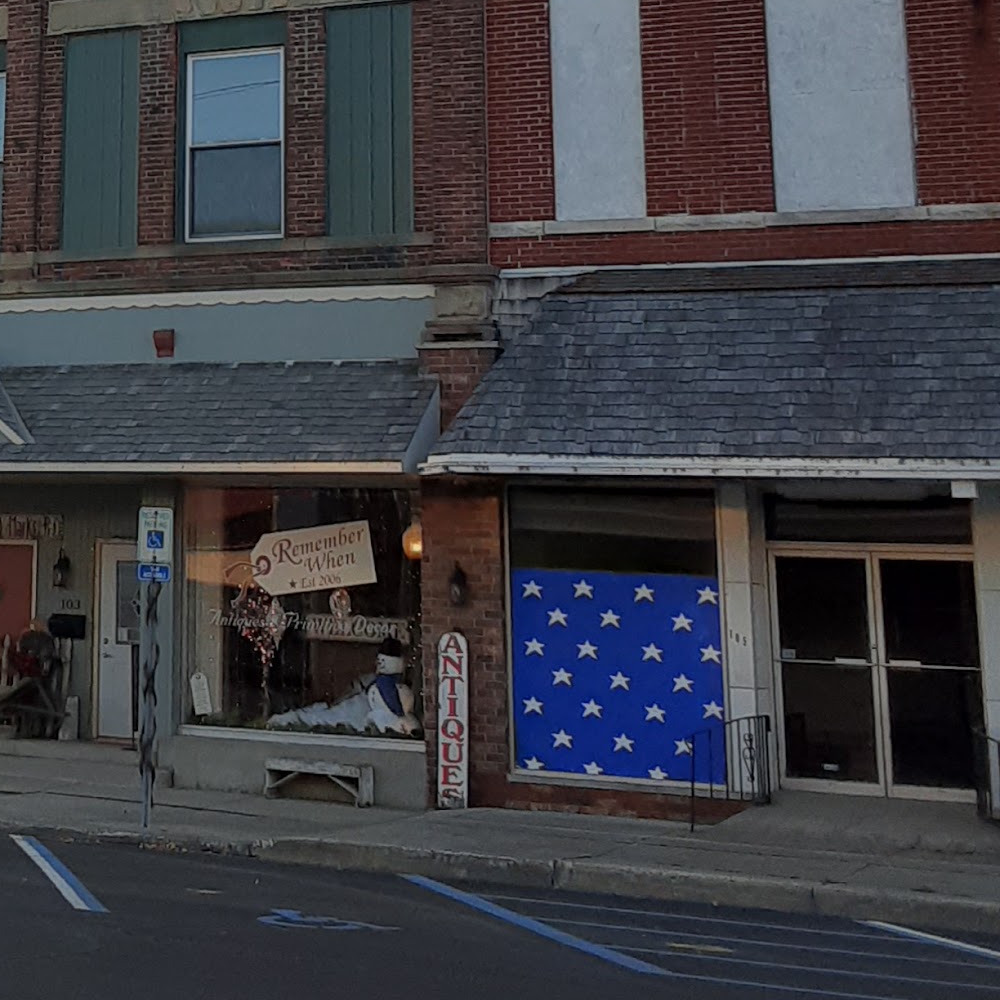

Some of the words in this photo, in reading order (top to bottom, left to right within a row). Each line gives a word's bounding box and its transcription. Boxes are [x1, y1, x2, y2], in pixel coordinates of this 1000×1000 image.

[271, 527, 365, 565] Remember
[303, 550, 357, 574] When
[318, 574, 342, 588] 2006
[60, 598, 81, 610] 103
[729, 628, 747, 647] 105
